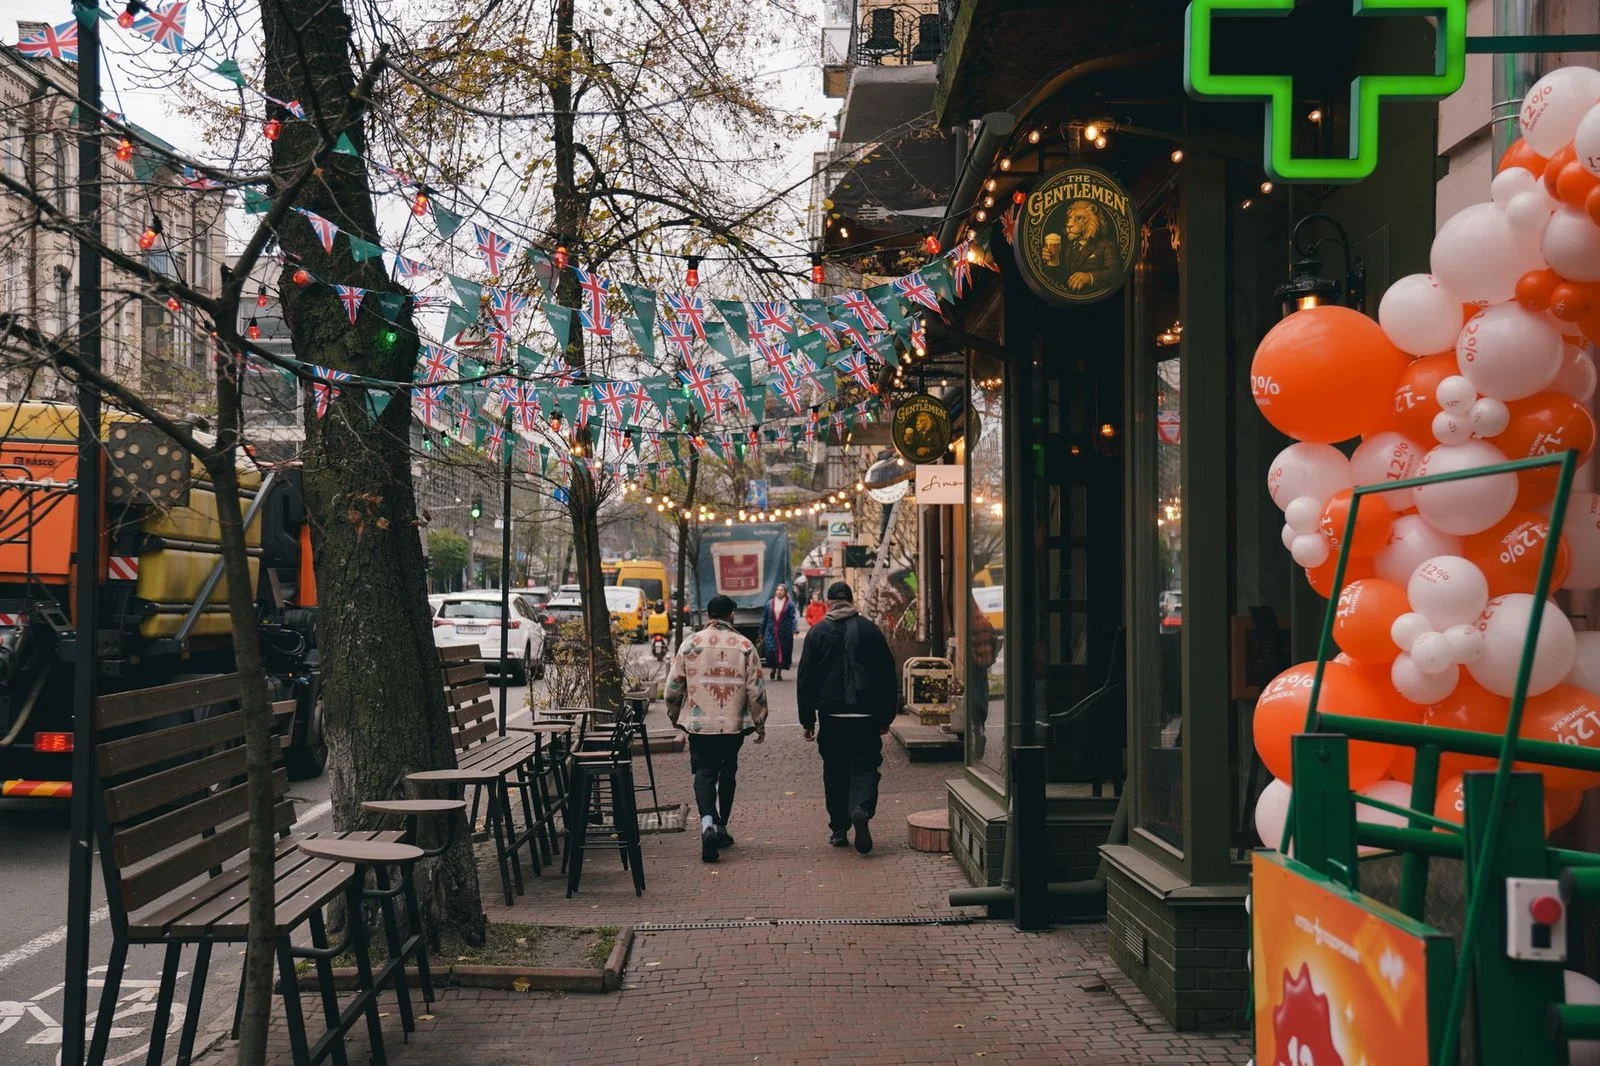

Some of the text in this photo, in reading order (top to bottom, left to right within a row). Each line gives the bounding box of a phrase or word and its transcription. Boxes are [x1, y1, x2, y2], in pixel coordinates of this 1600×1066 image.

[1067, 175, 1091, 183] THE
[1027, 183, 1129, 225] GENTLEMEN
[896, 403, 948, 424] GENTLEMEN
[1386, 442, 1409, 480] 12%
[1551, 704, 1589, 732] ЗНИЖКА
